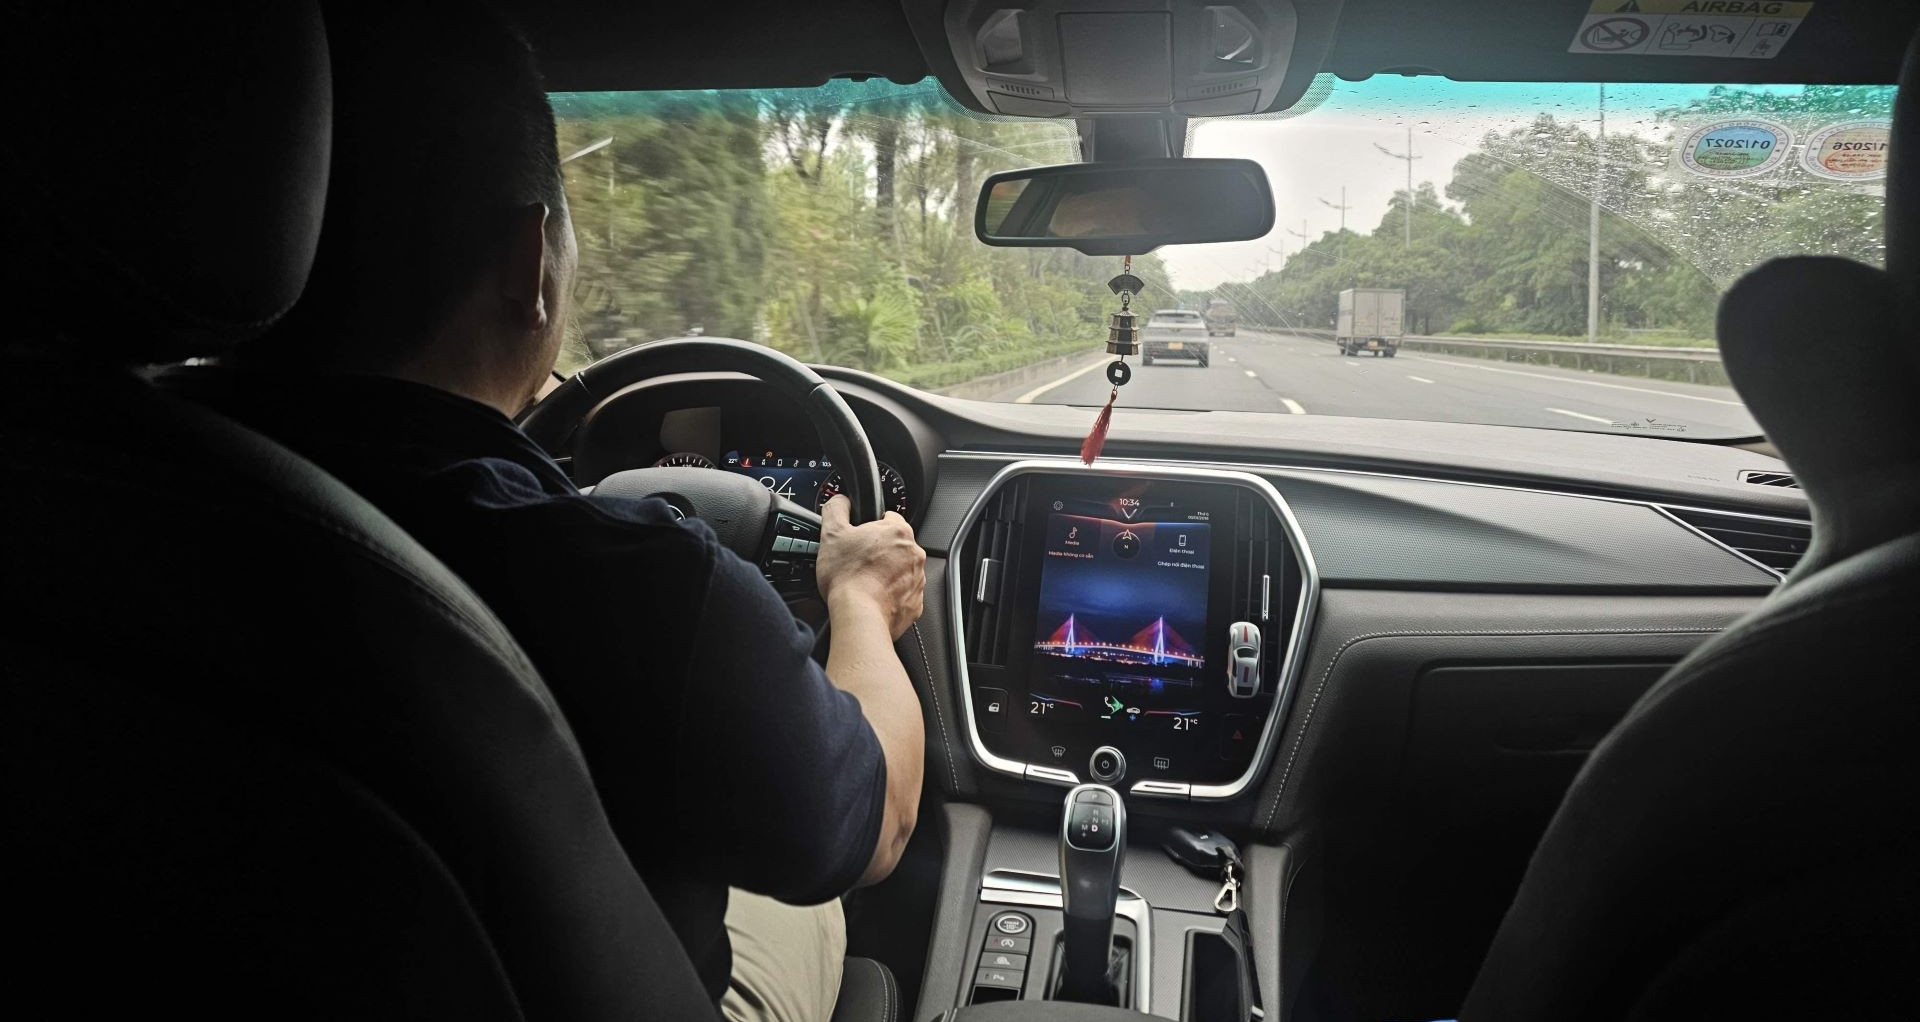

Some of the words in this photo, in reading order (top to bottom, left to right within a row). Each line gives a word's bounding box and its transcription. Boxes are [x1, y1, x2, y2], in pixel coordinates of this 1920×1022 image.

[1681, 1, 1784, 14] AIRBAG
[1119, 498, 1140, 507] 10:34
[1091, 824, 1098, 832] D
